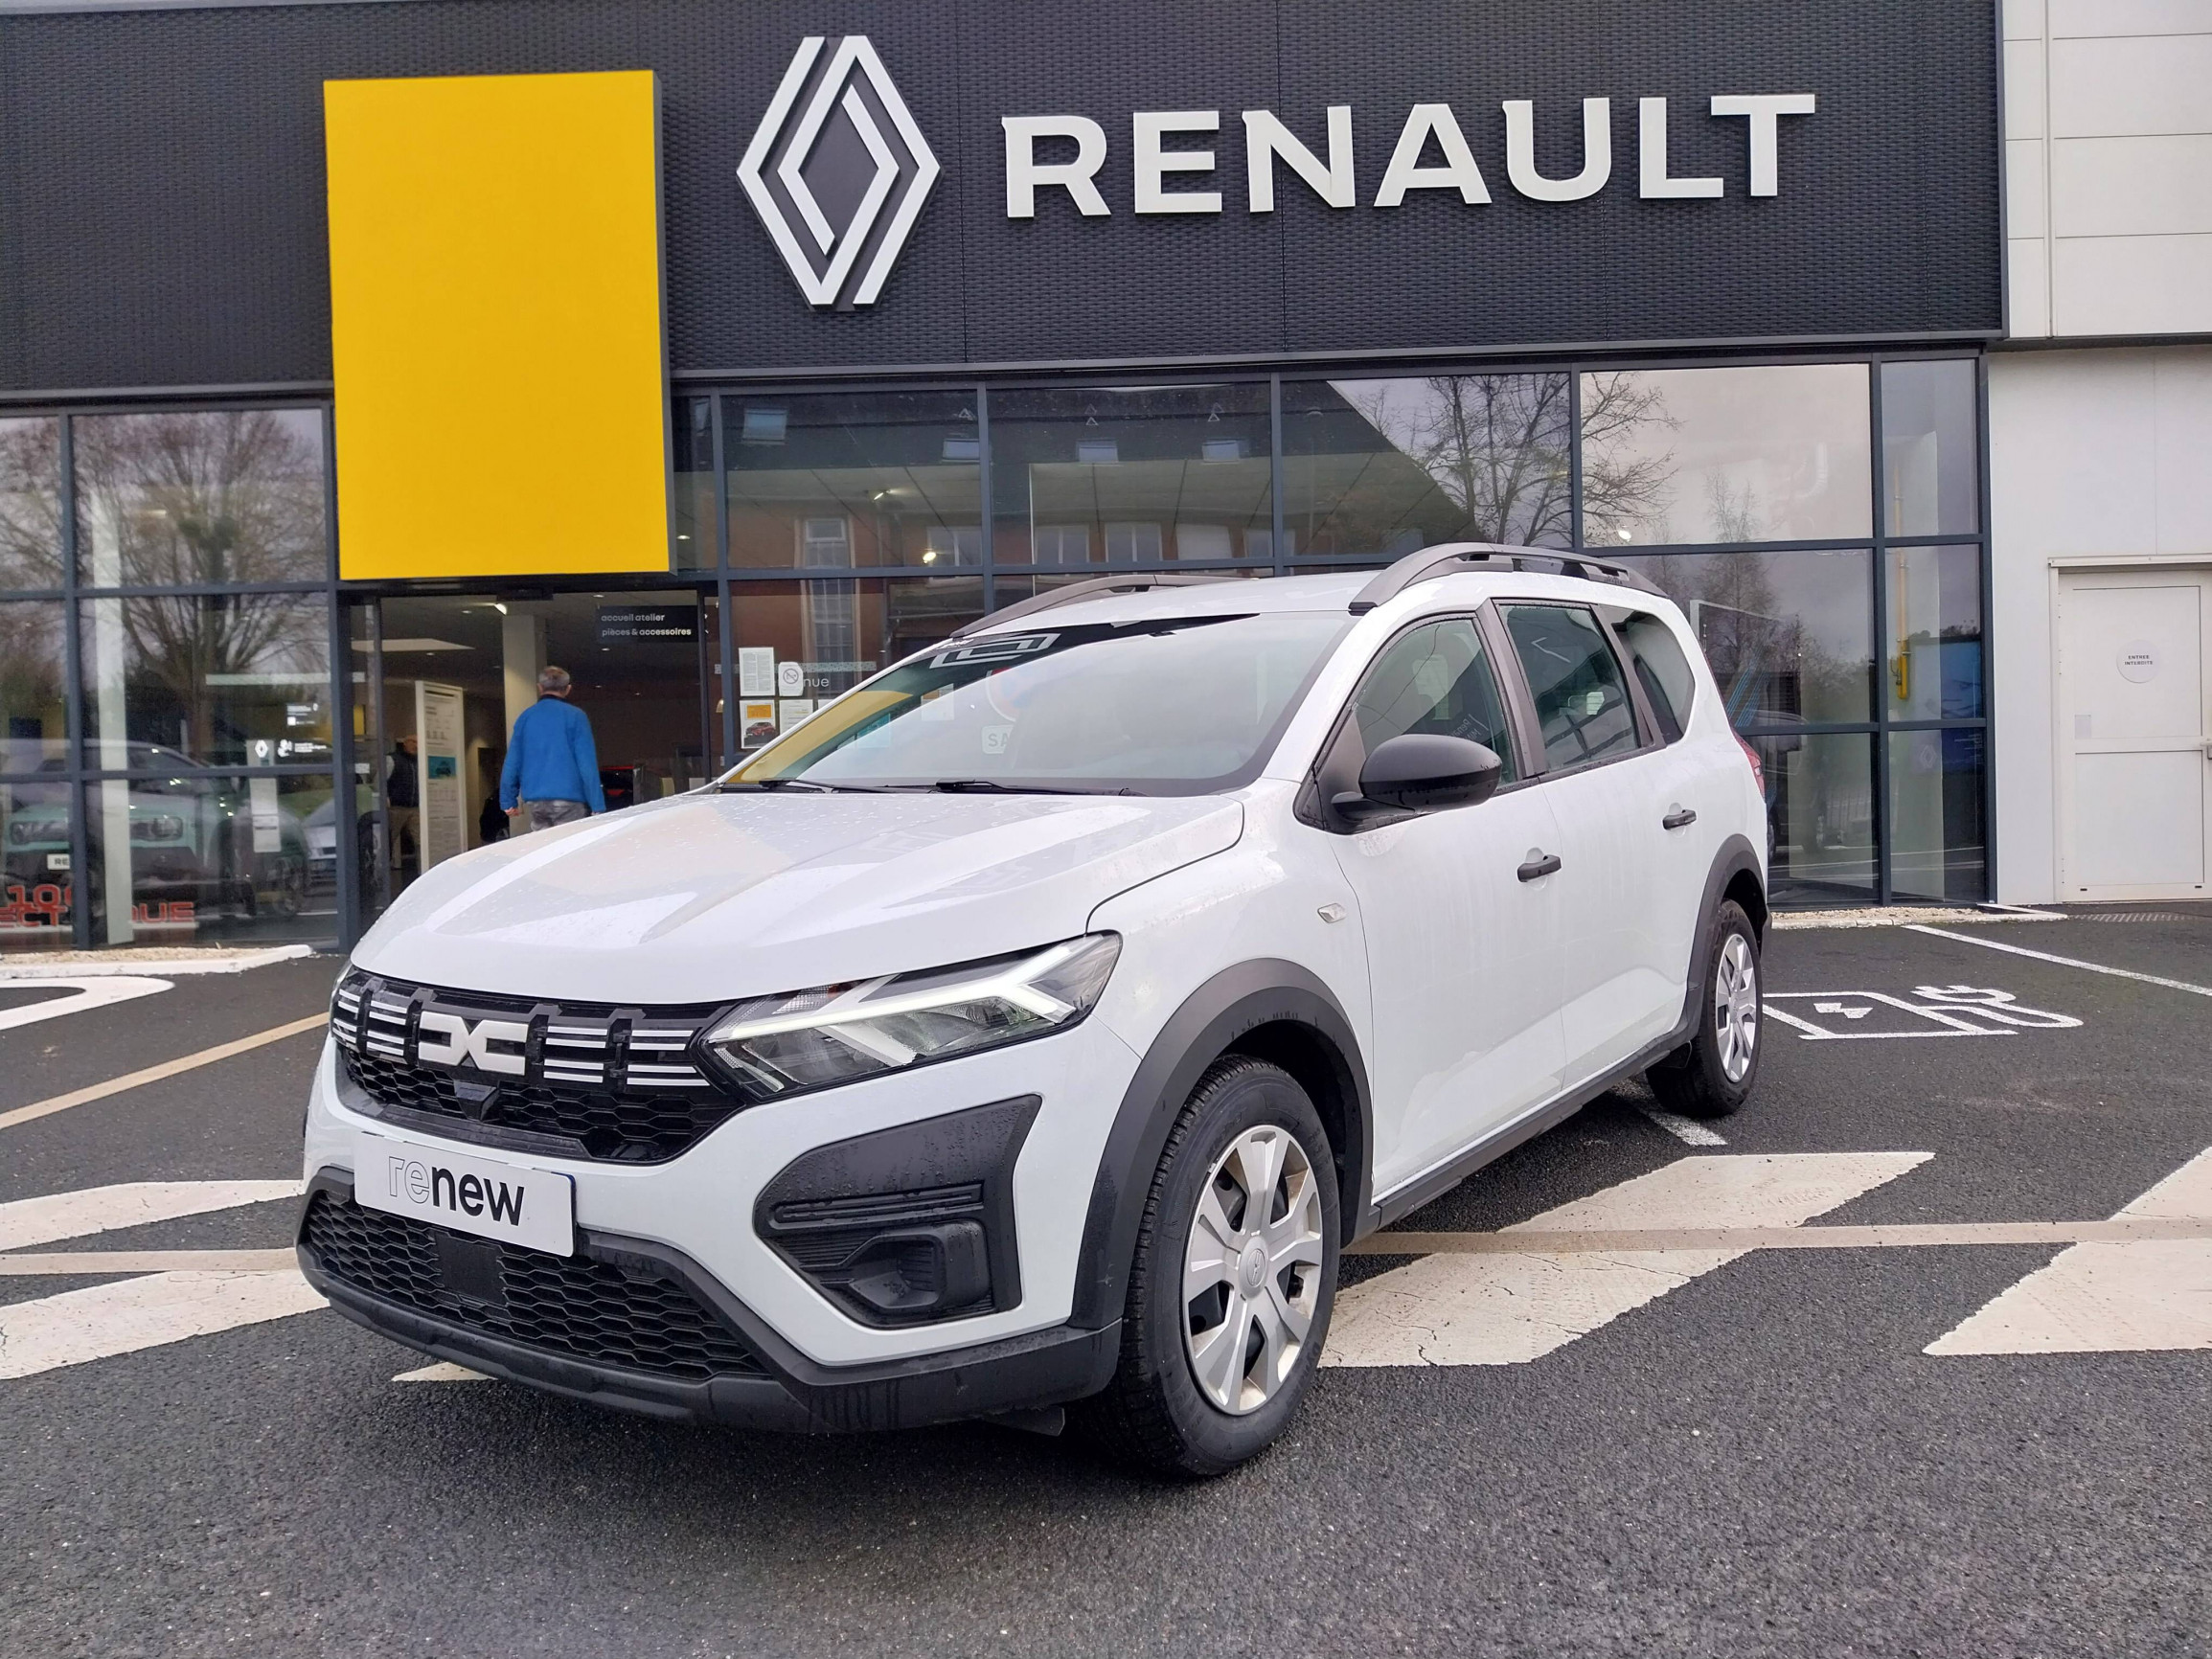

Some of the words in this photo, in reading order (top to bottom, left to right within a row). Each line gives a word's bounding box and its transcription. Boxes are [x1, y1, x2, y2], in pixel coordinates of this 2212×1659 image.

[1001, 93, 1815, 217] RENAULT
[601, 613, 633, 622] accueil
[635, 613, 665, 622] atelier
[602, 627, 630, 637] pièces
[639, 627, 692, 636] accessoires
[803, 677, 830, 688] nue
[8, 884, 72, 910] 10
[387, 1156, 525, 1227] renew
